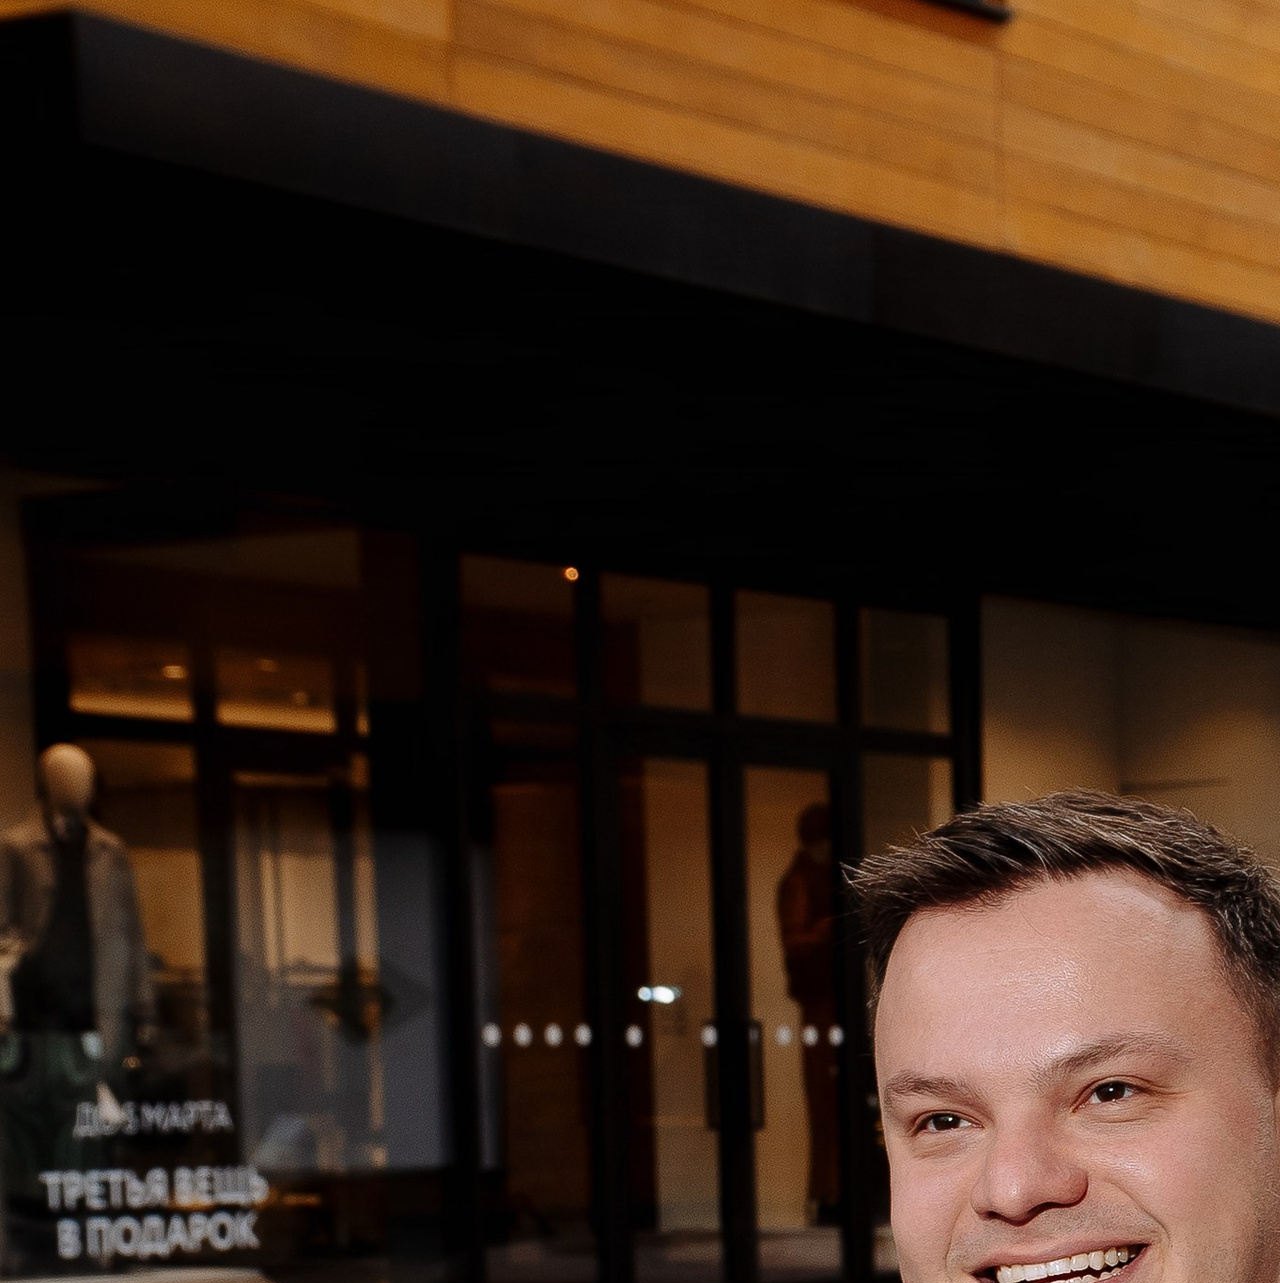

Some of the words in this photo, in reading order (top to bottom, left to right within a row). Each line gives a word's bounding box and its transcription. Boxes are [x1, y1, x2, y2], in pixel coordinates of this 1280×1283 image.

[140, 1100, 234, 1133] МАРТА
[39, 1167, 169, 1211] ТРЕТЬЯ
[173, 1165, 269, 1207] ВЕЩЬ
[57, 1217, 82, 1259] В
[85, 1210, 260, 1258] ПОДАРОК
